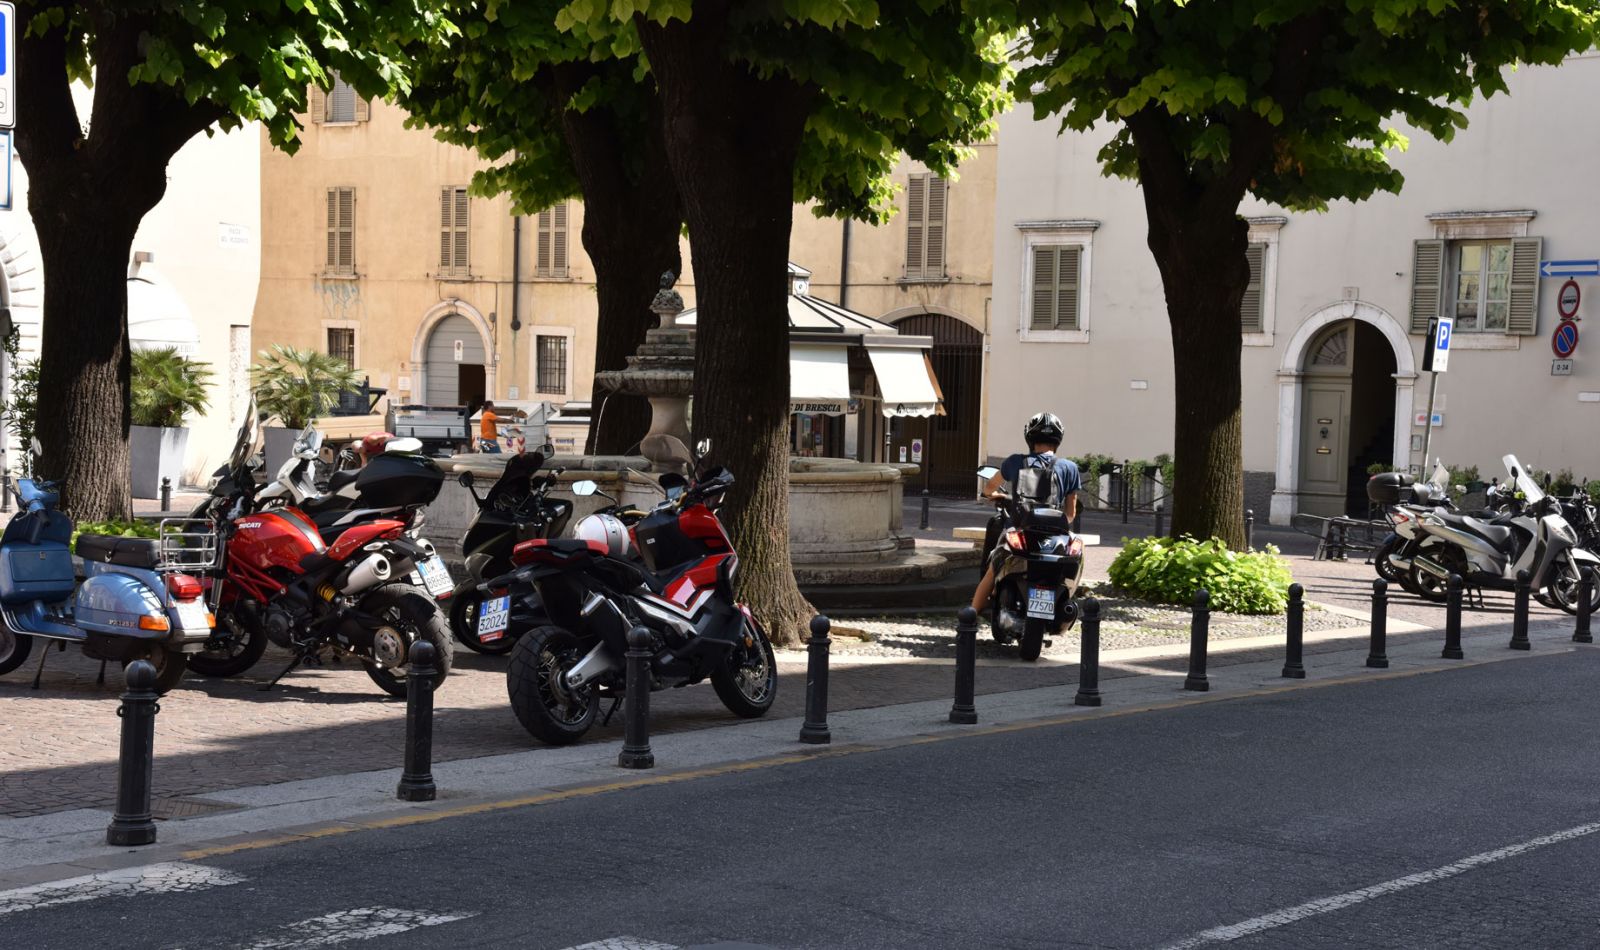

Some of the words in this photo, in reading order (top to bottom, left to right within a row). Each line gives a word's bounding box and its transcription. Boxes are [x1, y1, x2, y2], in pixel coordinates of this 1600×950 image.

[1439, 325, 1448, 347] P
[794, 403, 804, 411] DI
[805, 403, 841, 412] BRESCIA
[487, 599, 499, 613] EJ
[1030, 600, 1054, 612] 77570
[480, 612, 507, 631] 32024
